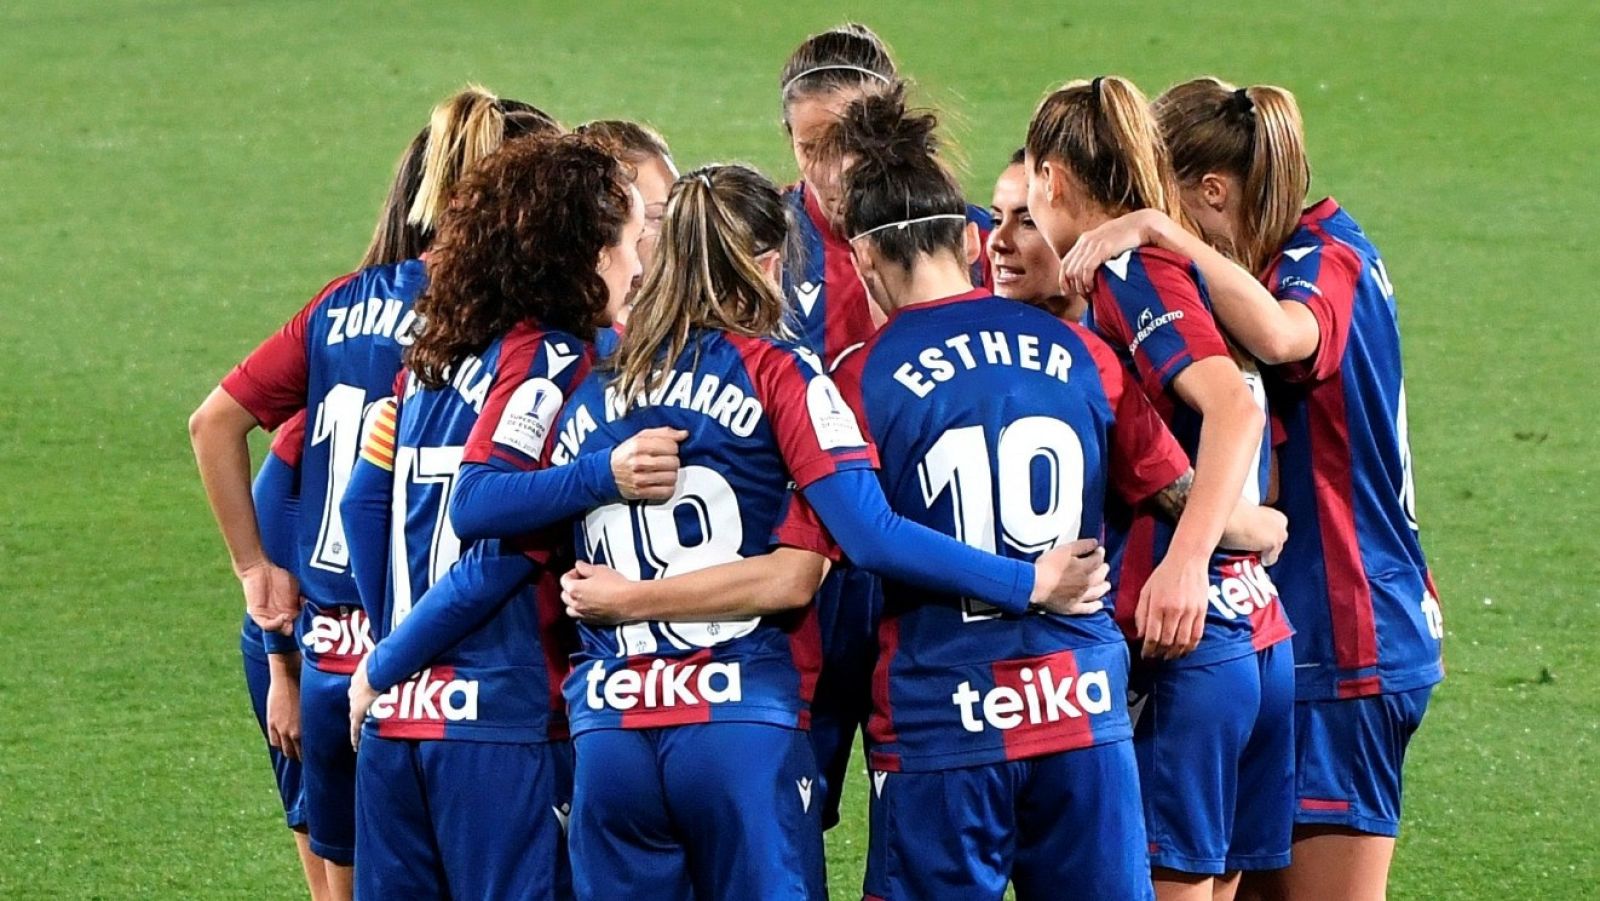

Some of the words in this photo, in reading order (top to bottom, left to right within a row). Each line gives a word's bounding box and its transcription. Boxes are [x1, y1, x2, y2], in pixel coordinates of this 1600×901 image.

[893, 331, 1072, 398] ESTHER
[551, 403, 598, 467] EVA
[392, 445, 464, 631] 17
[917, 416, 1084, 623] 19
[582, 465, 762, 657] 18
[1208, 560, 1279, 620] teik
[302, 606, 376, 655] eik
[366, 667, 479, 721] eika
[586, 659, 742, 710] teika
[952, 665, 1112, 732] teika
